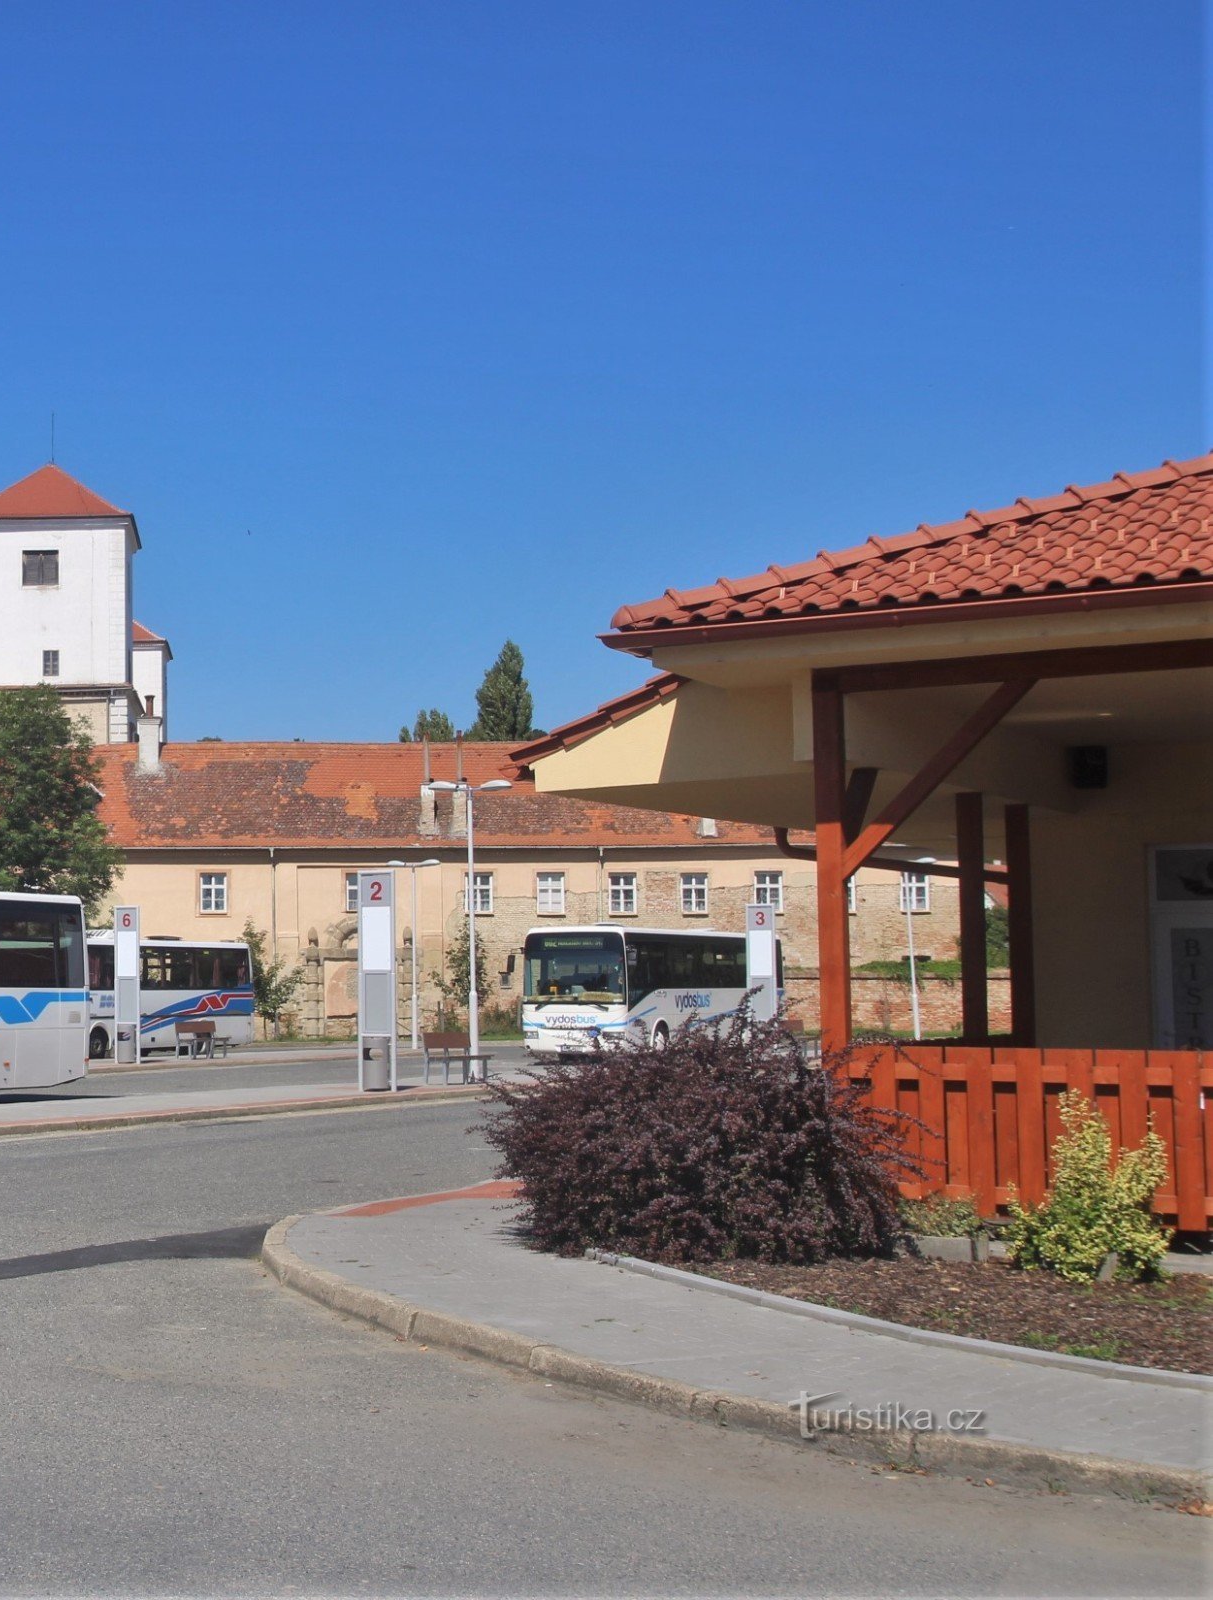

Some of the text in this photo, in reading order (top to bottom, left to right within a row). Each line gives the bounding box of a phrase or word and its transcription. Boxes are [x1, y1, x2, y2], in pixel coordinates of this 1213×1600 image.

[370, 881, 382, 901] 2
[122, 913, 131, 928] 6
[755, 911, 765, 926] 3
[545, 1014, 596, 1025] vydosbus
